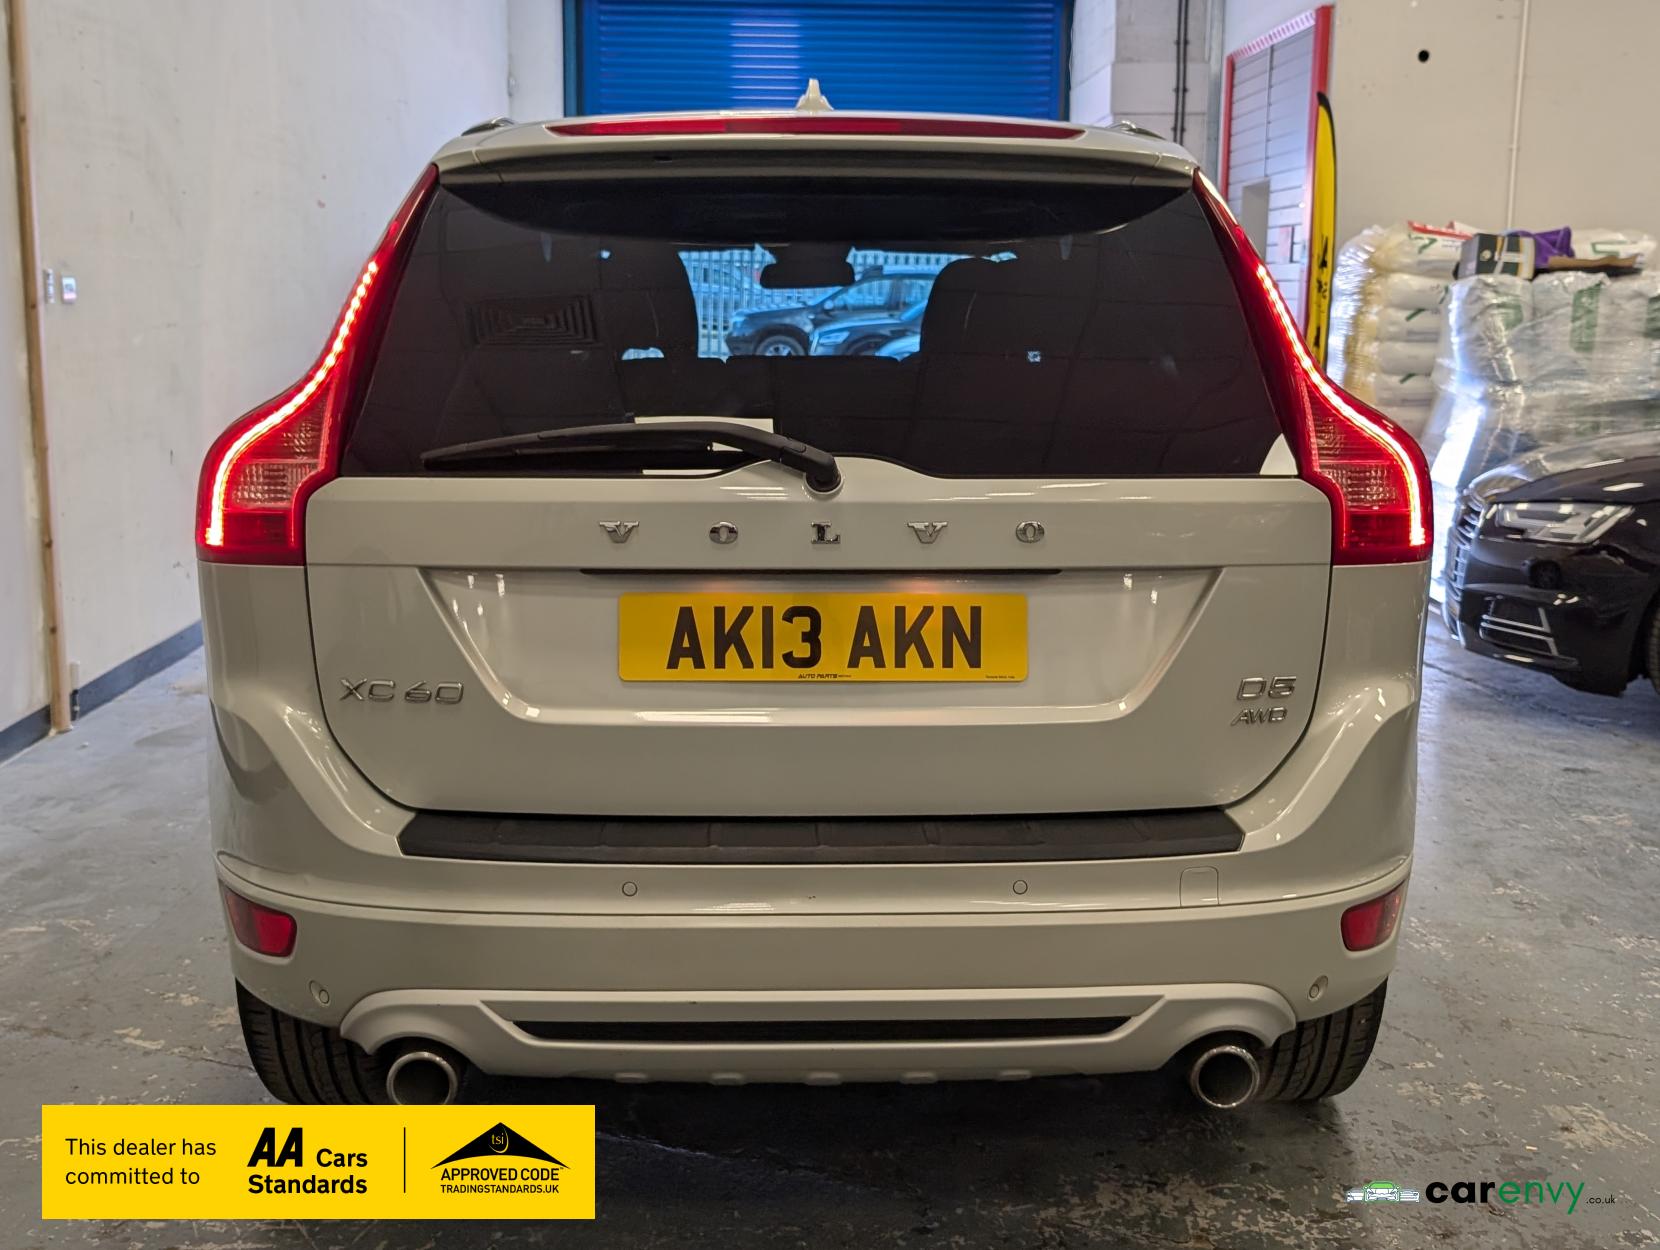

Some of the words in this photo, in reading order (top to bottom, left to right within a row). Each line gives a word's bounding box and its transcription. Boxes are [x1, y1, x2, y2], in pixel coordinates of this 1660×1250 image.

[599, 520, 1046, 545] VOLVO
[666, 605, 822, 670] AK13
[847, 605, 982, 669] AKN
[1236, 675, 1297, 700] D5
[1230, 706, 1288, 727] AWD
